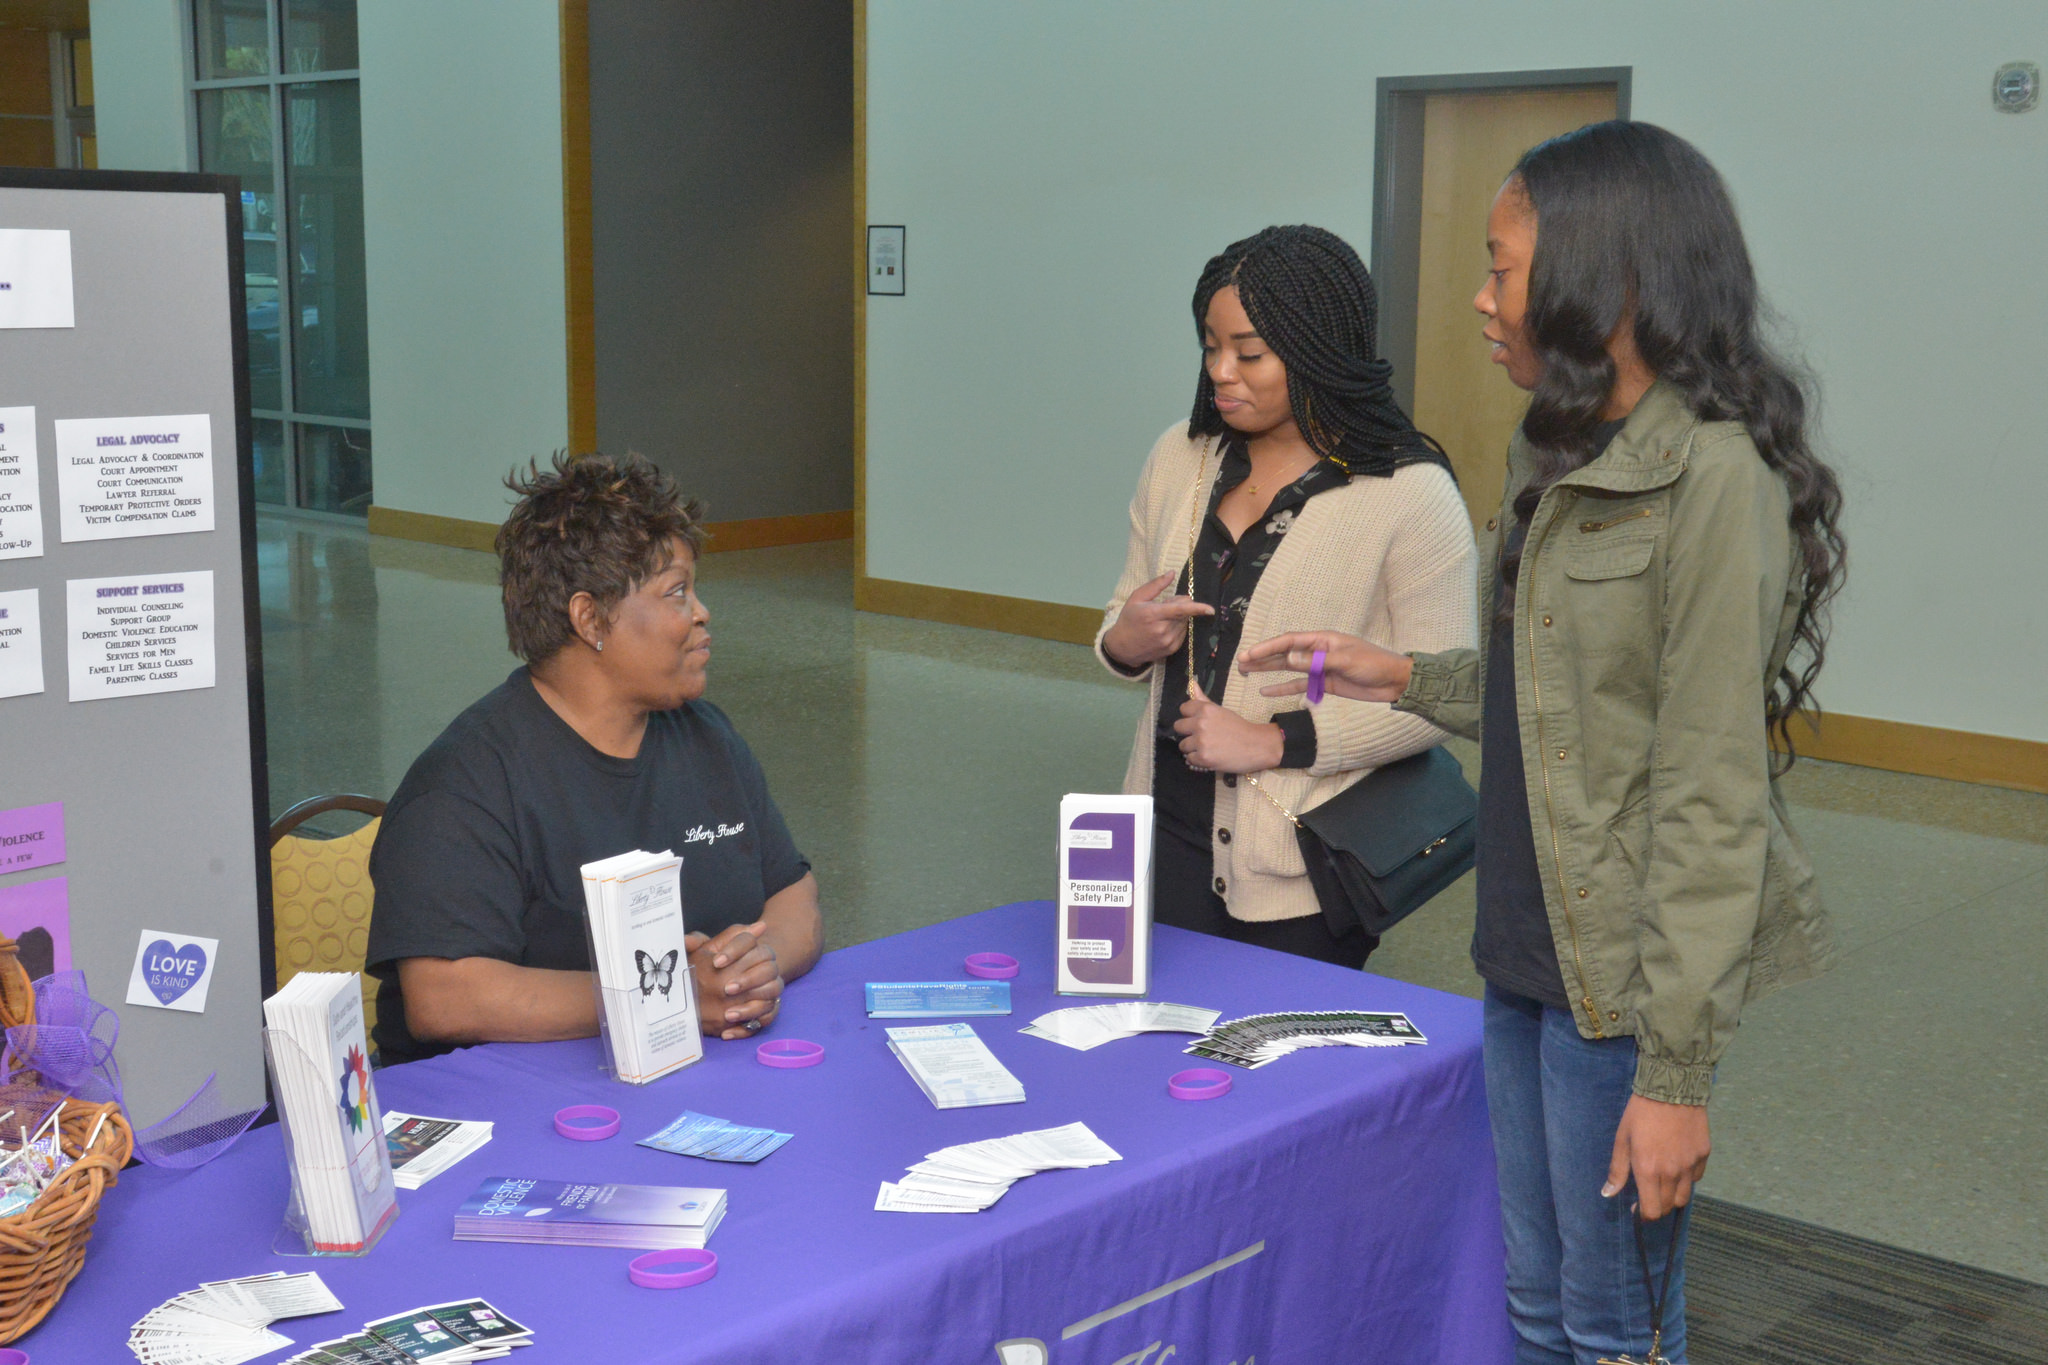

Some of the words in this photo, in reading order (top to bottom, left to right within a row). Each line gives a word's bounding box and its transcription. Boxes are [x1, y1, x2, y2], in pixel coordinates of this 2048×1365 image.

[96, 436, 126, 446] LEGAL
[130, 434, 180, 446] ADVOCACY
[72, 457, 94, 465] LEGAL
[99, 456, 138, 464] ADVOCACY
[142, 454, 148, 462] &
[153, 452, 204, 461] COORDINATION
[101, 467, 124, 476] COURT
[130, 465, 178, 474] APPOINTMENT
[98, 480, 121, 488] COURT
[126, 476, 183, 486] COMMUNICATION
[106, 491, 136, 500] LAWYER
[140, 488, 176, 498] REFERRAL
[0, 504, 32, 513] OCATION
[79, 504, 123, 513] TEMPORARY
[128, 501, 170, 510] PROTECTIVE
[174, 498, 201, 506] ORDERS
[86, 516, 111, 524] VICTIM
[115, 512, 168, 522] COMPENSATION
[172, 510, 196, 518] CLAIMS
[96, 586, 139, 598] SUPPORT
[142, 583, 184, 595] SERVICES
[97, 606, 138, 615] INDIVIDUAL
[141, 602, 184, 612] COUNSELING
[110, 617, 143, 626] SUPPORT
[146, 614, 171, 624] GROUP
[82, 630, 118, 640] DOMESTIC
[122, 627, 156, 637] VIOLENCE
[160, 624, 198, 633] EDUCATION
[106, 640, 140, 650] CHILDREN
[144, 637, 176, 646] SERVICES
[106, 652, 139, 661] SERVICES
[143, 650, 156, 658] FOR
[160, 648, 176, 656] MEN
[89, 665, 115, 674] FAMILY
[119, 664, 134, 672] LIFE
[138, 661, 161, 670] SKILLS
[165, 659, 193, 667] CLASSES
[106, 674, 146, 684] PARENTING
[149, 672, 178, 680] CLASSES
[684, 824, 714, 845] Liberty
[716, 822, 744, 838] House
[1070, 882, 1128, 892] Personalized
[1074, 892, 1101, 904] Safety
[1104, 894, 1124, 903] Plan
[150, 954, 198, 976] LOVE
[151, 974, 160, 985] IS
[162, 975, 189, 988] KIND
[479, 1178, 521, 1216] DOMESTIC
[494, 1179, 537, 1216] VIOLENCE
